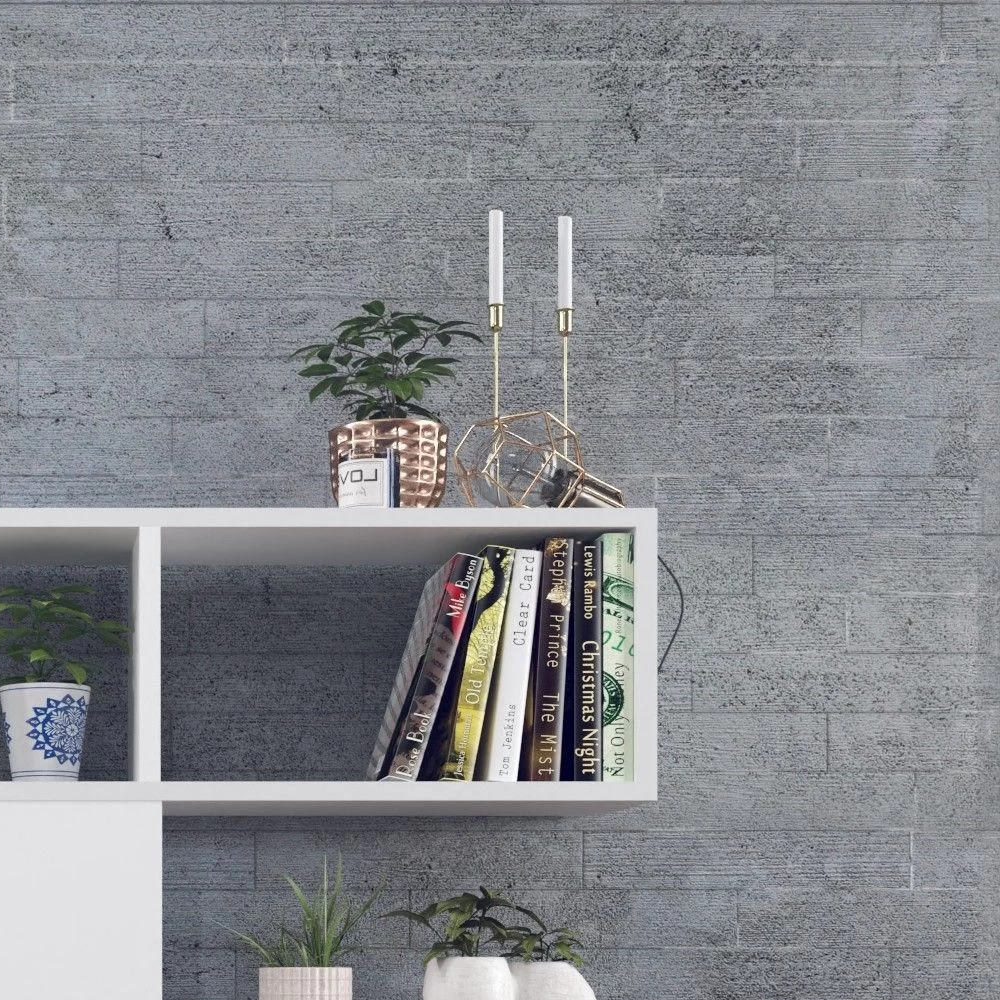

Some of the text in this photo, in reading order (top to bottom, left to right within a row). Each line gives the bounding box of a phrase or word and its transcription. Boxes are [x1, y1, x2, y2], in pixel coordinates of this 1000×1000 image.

[447, 558, 478, 618] Mike Byson
[512, 555, 536, 646] Clear Card
[583, 545, 596, 620] Lewis Rambo
[546, 614, 565, 668] Prince
[465, 678, 484, 705] Old
[575, 640, 600, 775] Christmas Night
[396, 711, 432, 777] Rose Book
[500, 704, 517, 776] Tom Jenkins
[538, 692, 560, 776] The Mist
[610, 714, 630, 747] Only
[454, 751, 466, 776] Jessica
[610, 752, 625, 778] Not
